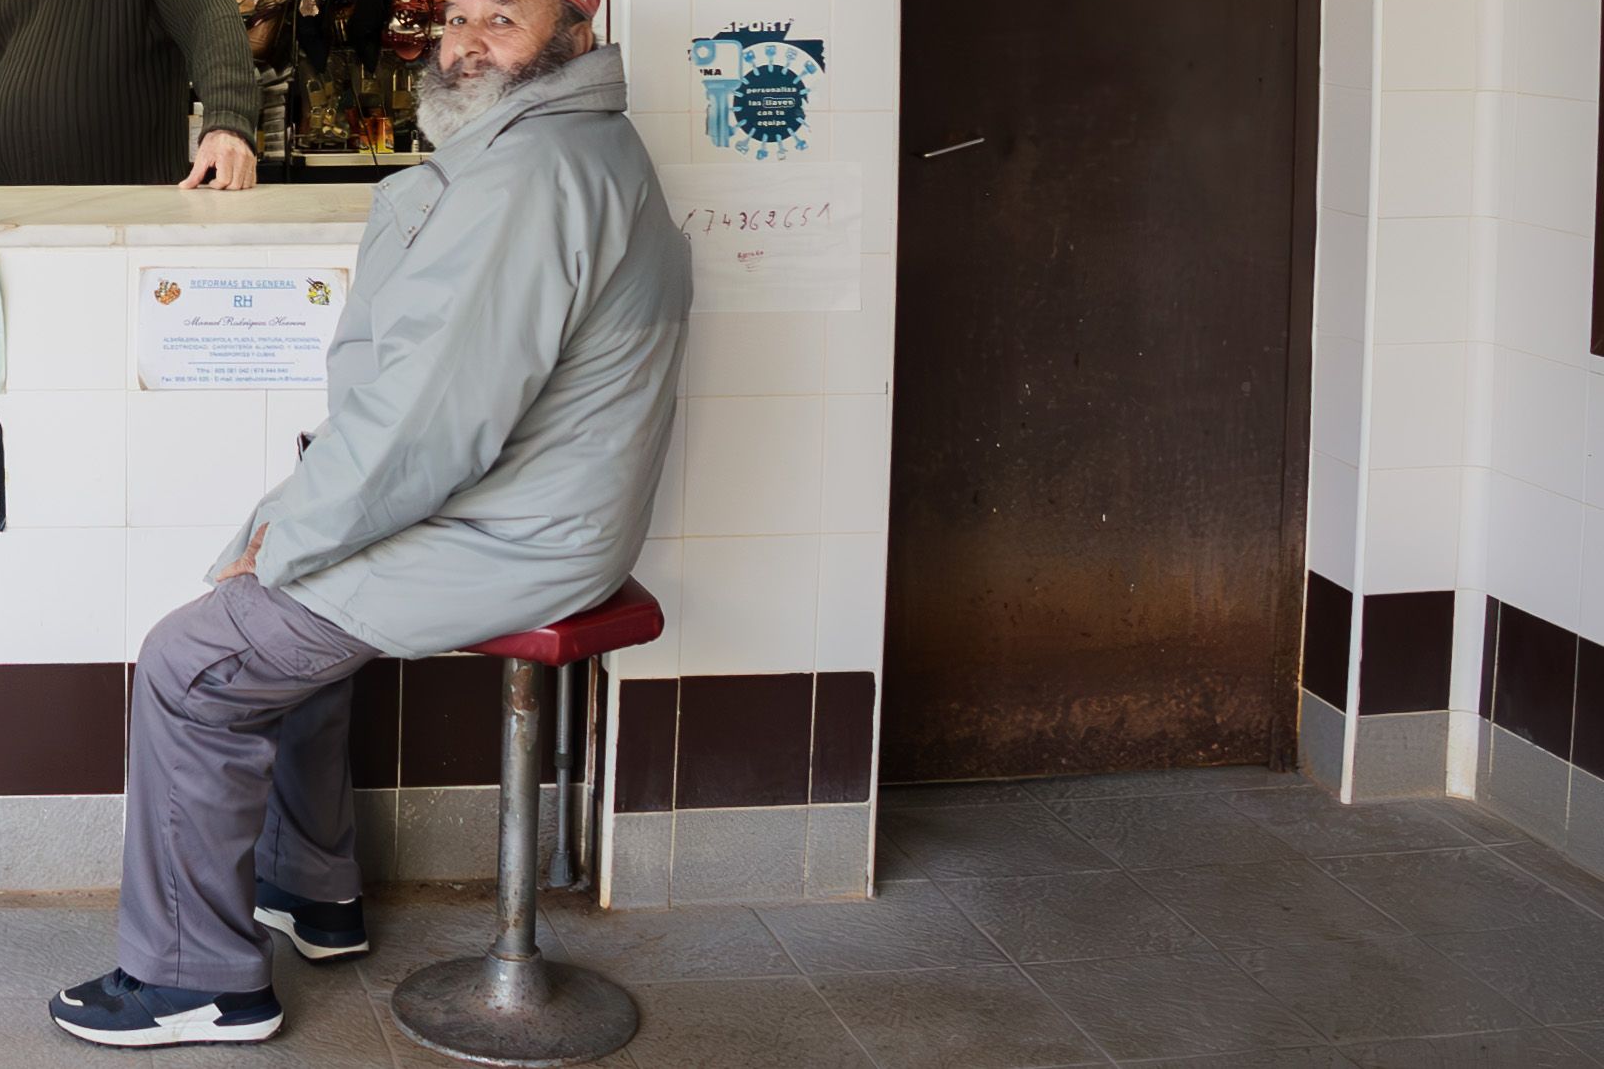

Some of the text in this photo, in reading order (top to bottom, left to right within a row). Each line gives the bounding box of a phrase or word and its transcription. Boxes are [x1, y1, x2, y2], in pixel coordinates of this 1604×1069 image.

[190, 279, 297, 288] REFORMAS EN GENERAL
[233, 295, 253, 308] RH
